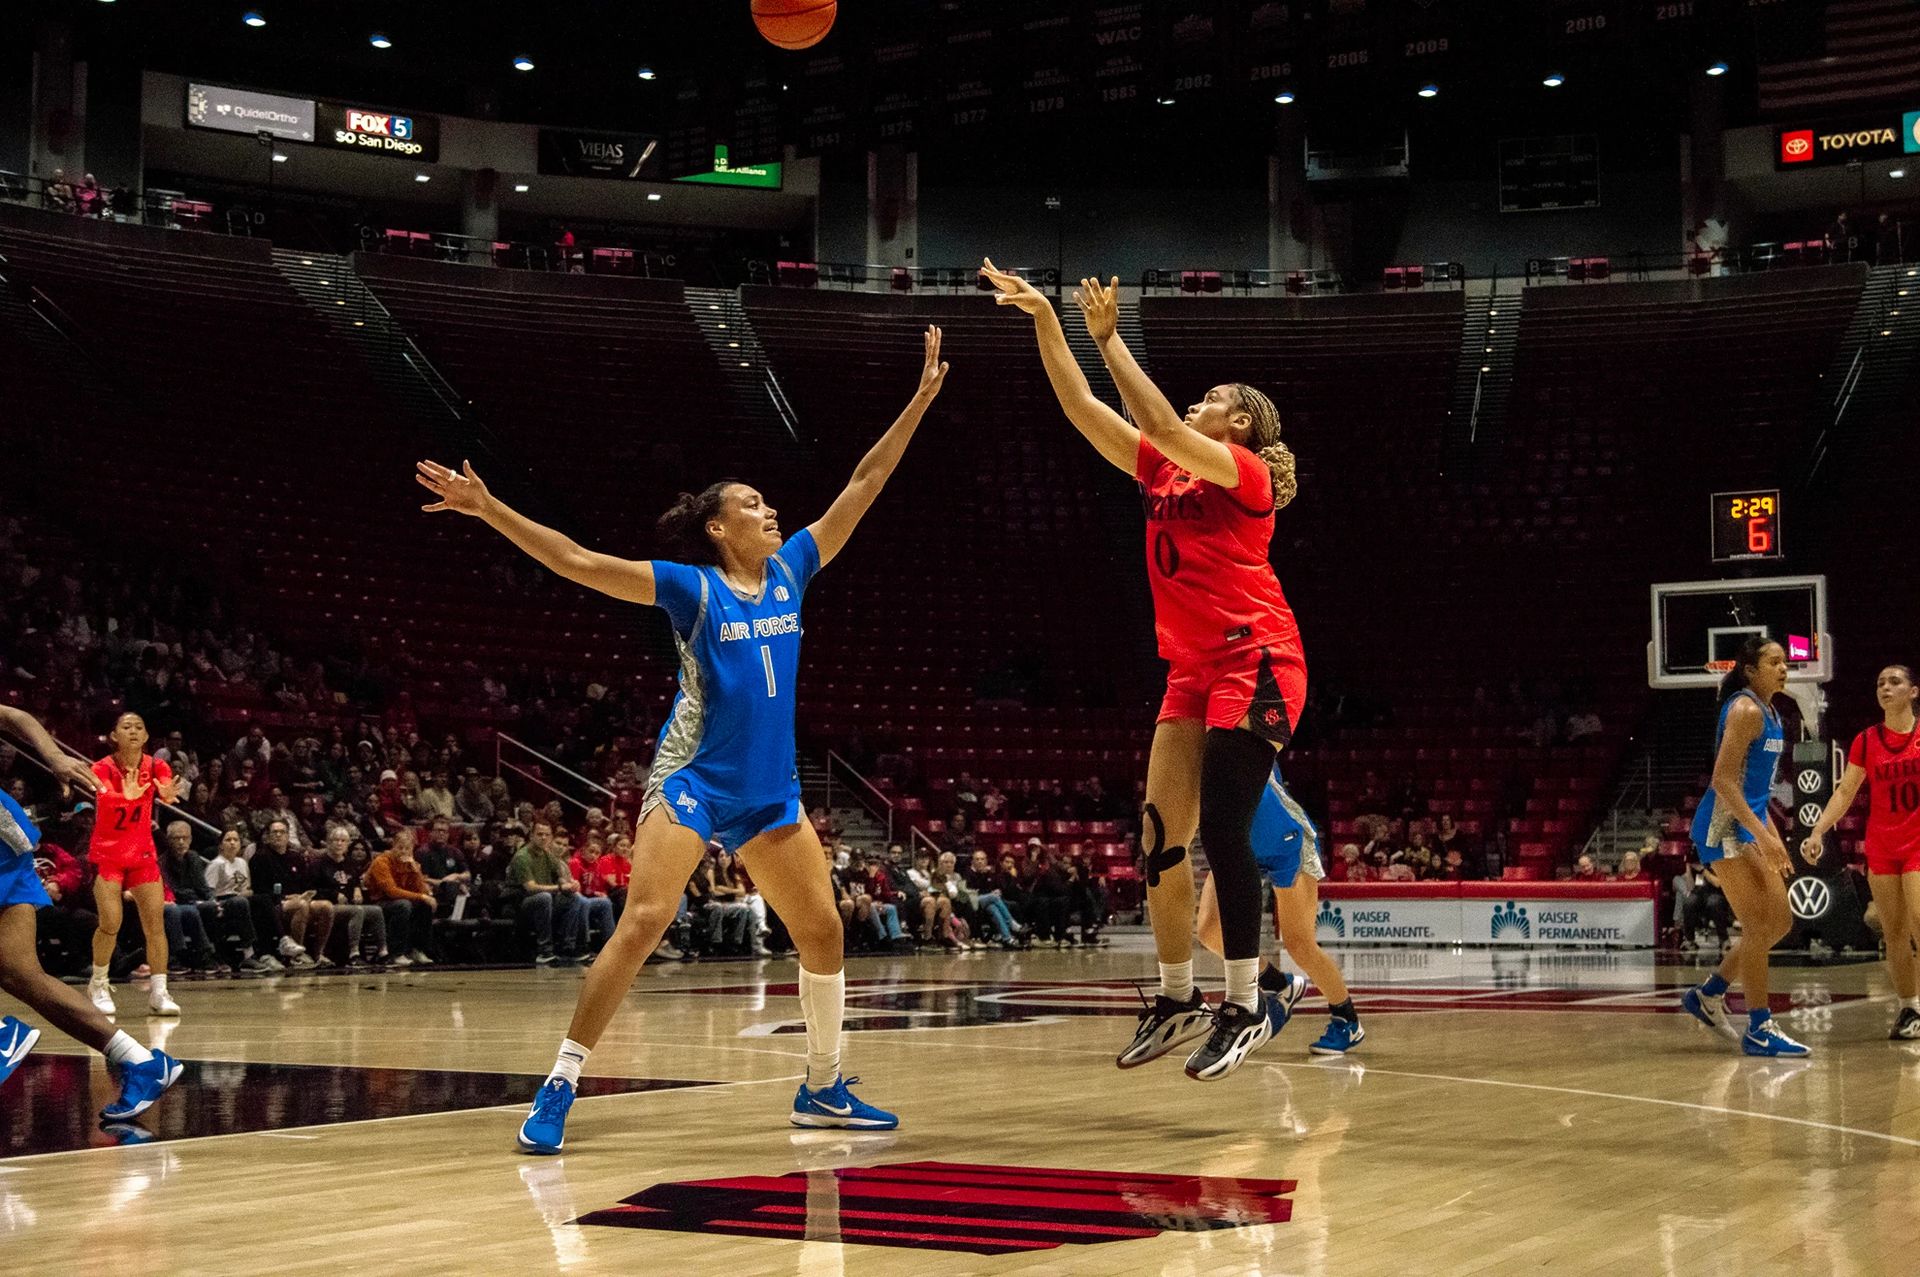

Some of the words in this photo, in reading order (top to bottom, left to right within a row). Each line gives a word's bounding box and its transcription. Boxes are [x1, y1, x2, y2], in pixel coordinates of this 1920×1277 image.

[1566, 15, 1607, 34] 2010
[1095, 26, 1142, 46] WAC
[1405, 38, 1448, 57] 2009
[1102, 84, 1136, 102] 1985
[234, 106, 298, 124] QuidelOrtho
[350, 111, 390, 135] FOX
[394, 118, 408, 137] 5
[358, 133, 382, 149] San
[385, 137, 422, 155] Diego
[578, 139, 624, 159] VIEJAS
[1819, 128, 1896, 151] TOYOTA
[665, 254, 676, 267] C
[1530, 260, 1540, 273] B
[1731, 497, 1774, 518] 2:29
[1748, 518, 1769, 552] 6
[1155, 530, 1180, 579] 0
[720, 622, 751, 642] AIR
[753, 613, 799, 638] FORCE
[760, 645, 776, 697] 1
[1798, 769, 1821, 793] VW
[1889, 782, 1919, 813] 10
[113, 806, 143, 831] 24
[1799, 803, 1822, 827] VW
[1788, 876, 1830, 919] VW
[1352, 911, 1391, 923] KAISER
[1538, 911, 1579, 924] KAISER
[1353, 926, 1431, 938] PERMANENTE
[1539, 927, 1621, 940] PERMANENTE
